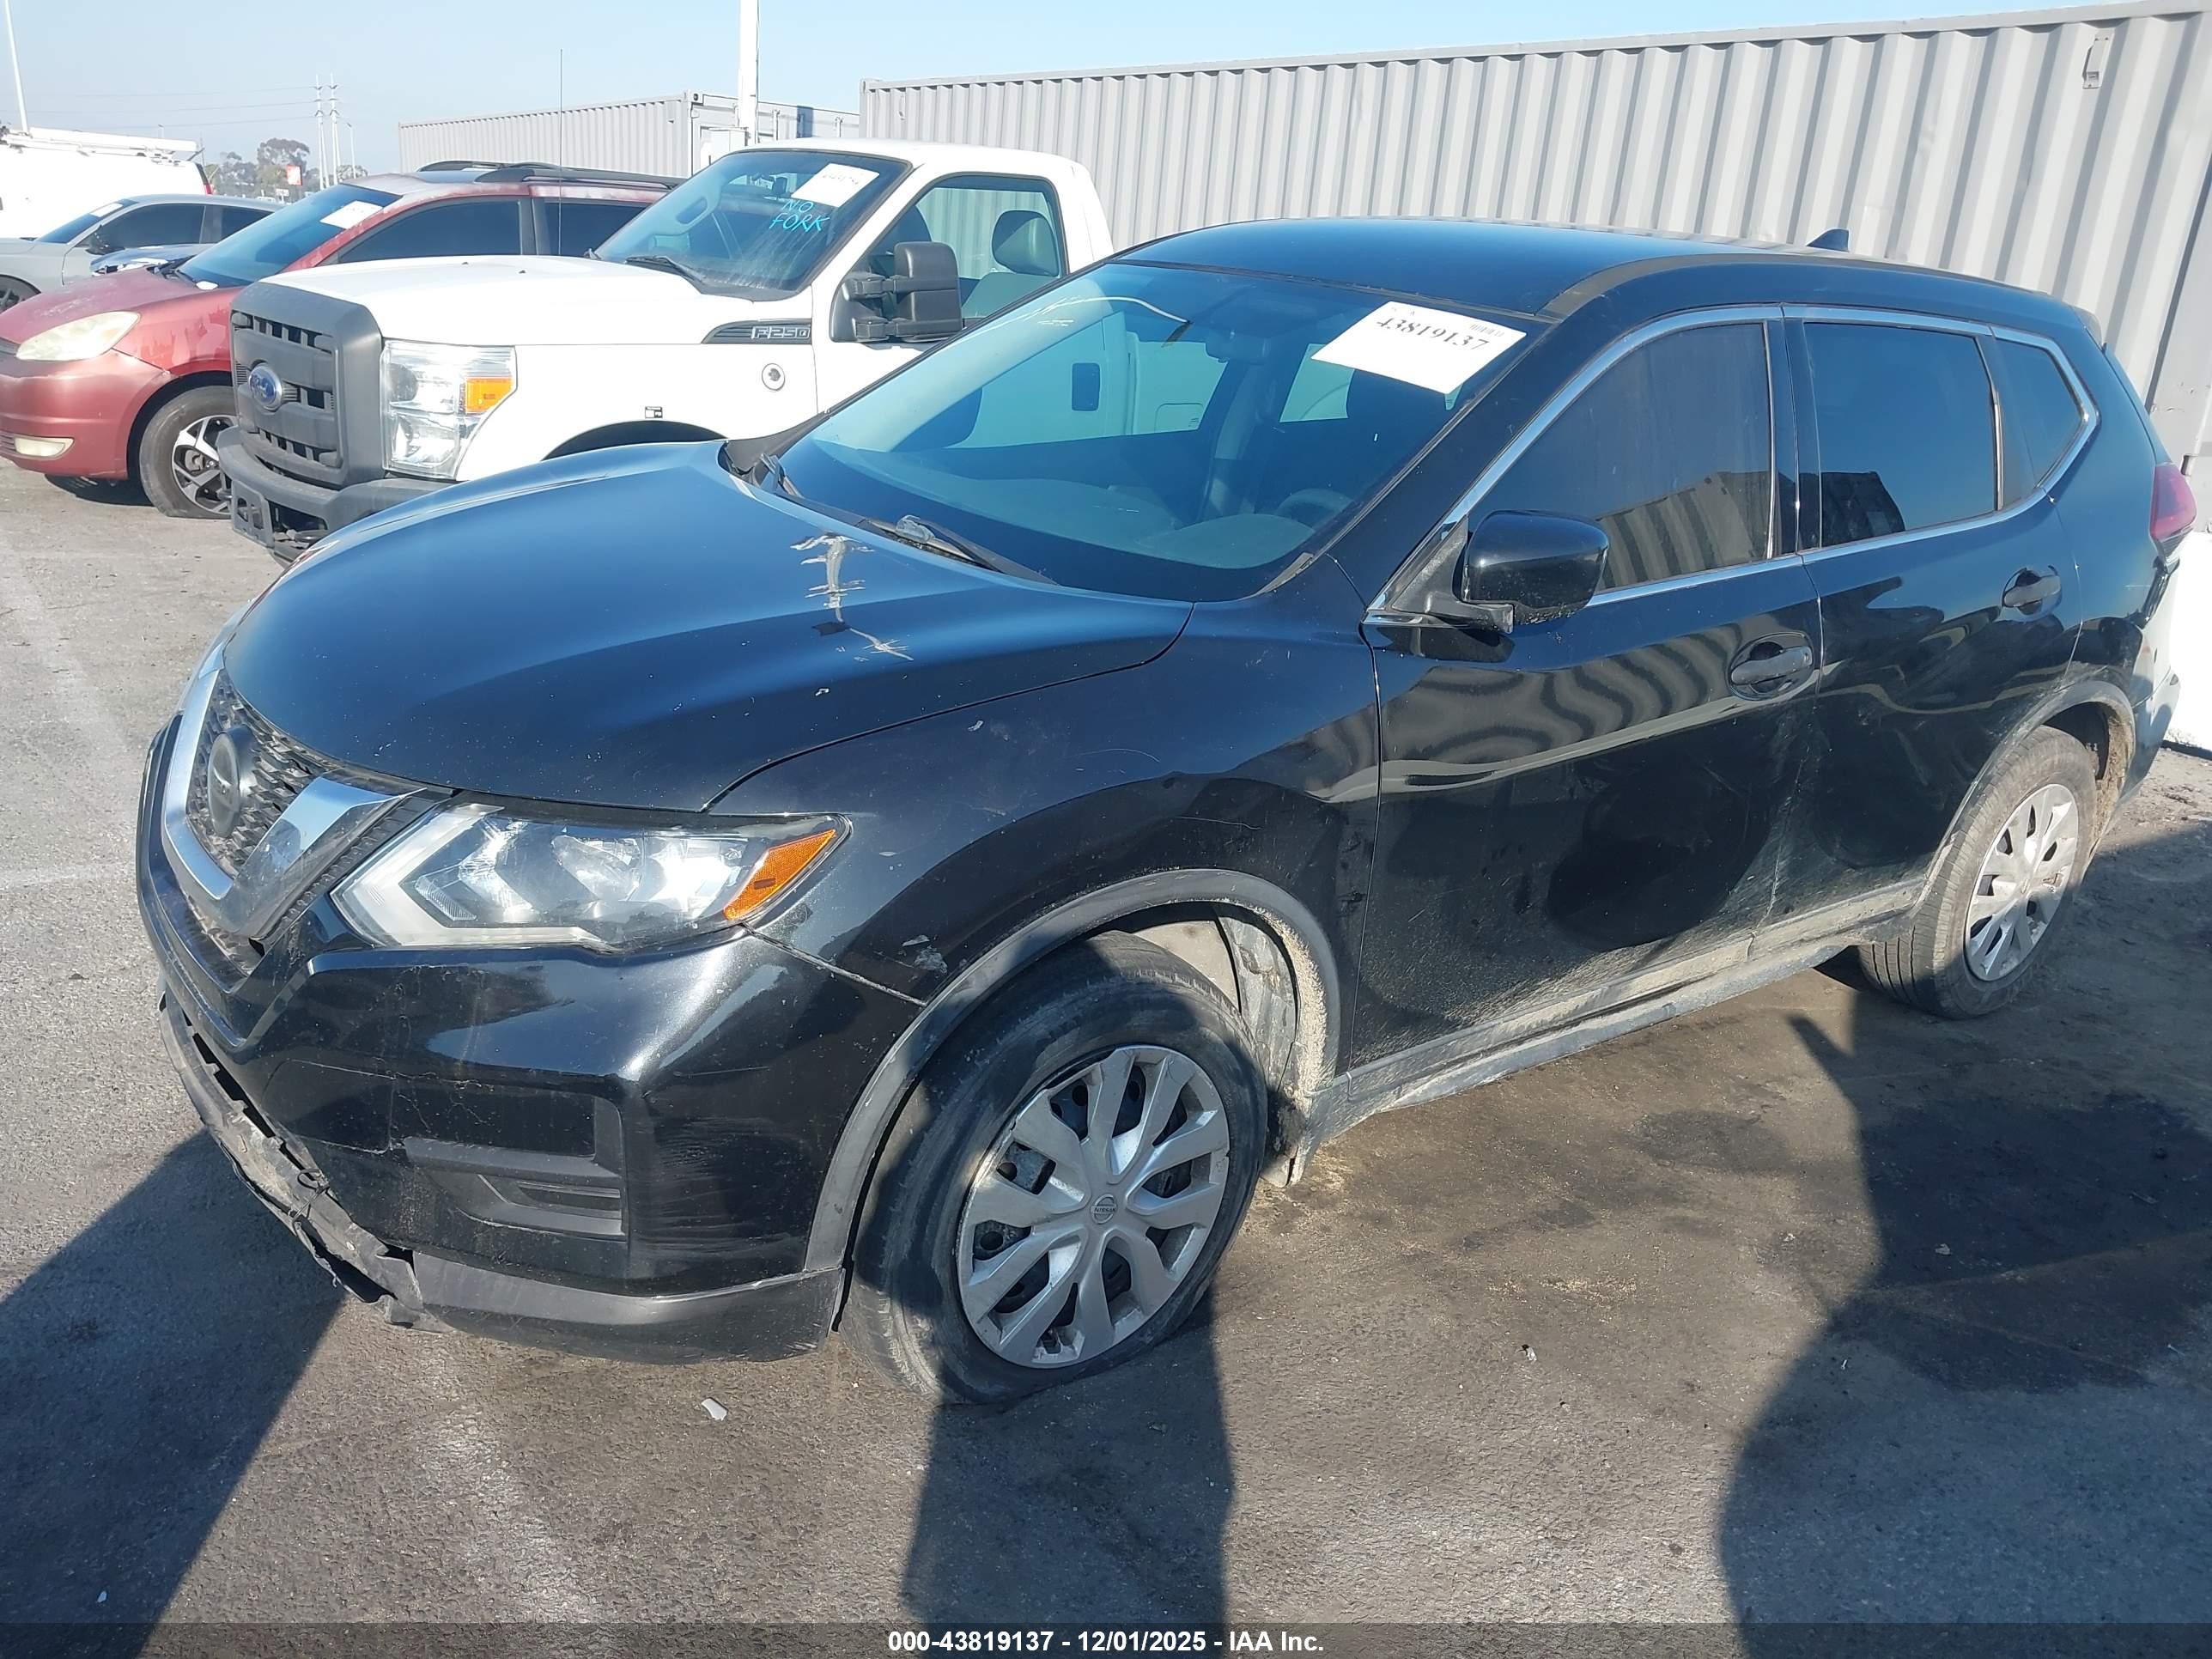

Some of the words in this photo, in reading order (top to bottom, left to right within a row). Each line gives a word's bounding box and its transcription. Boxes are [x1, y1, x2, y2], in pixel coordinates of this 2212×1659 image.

[781, 198, 815, 213] NO
[769, 213, 830, 232] FORK
[1376, 317, 1490, 350] 43819137
